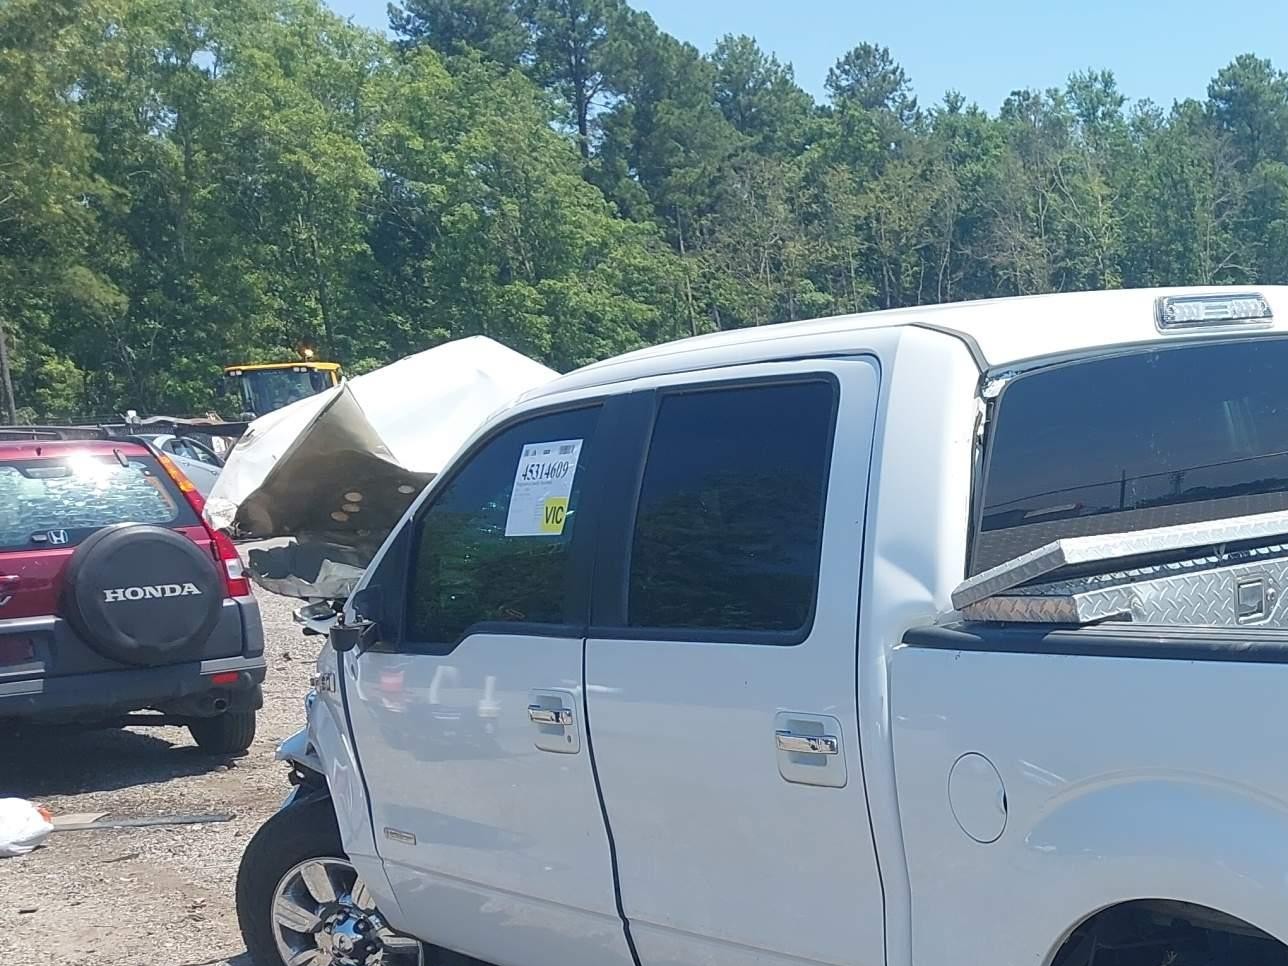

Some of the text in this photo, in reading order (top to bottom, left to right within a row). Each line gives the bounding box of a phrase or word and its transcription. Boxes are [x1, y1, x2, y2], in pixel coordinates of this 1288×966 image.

[521, 461, 569, 481] 45314609
[545, 505, 564, 525] VIC
[103, 582, 202, 602] HONDA
